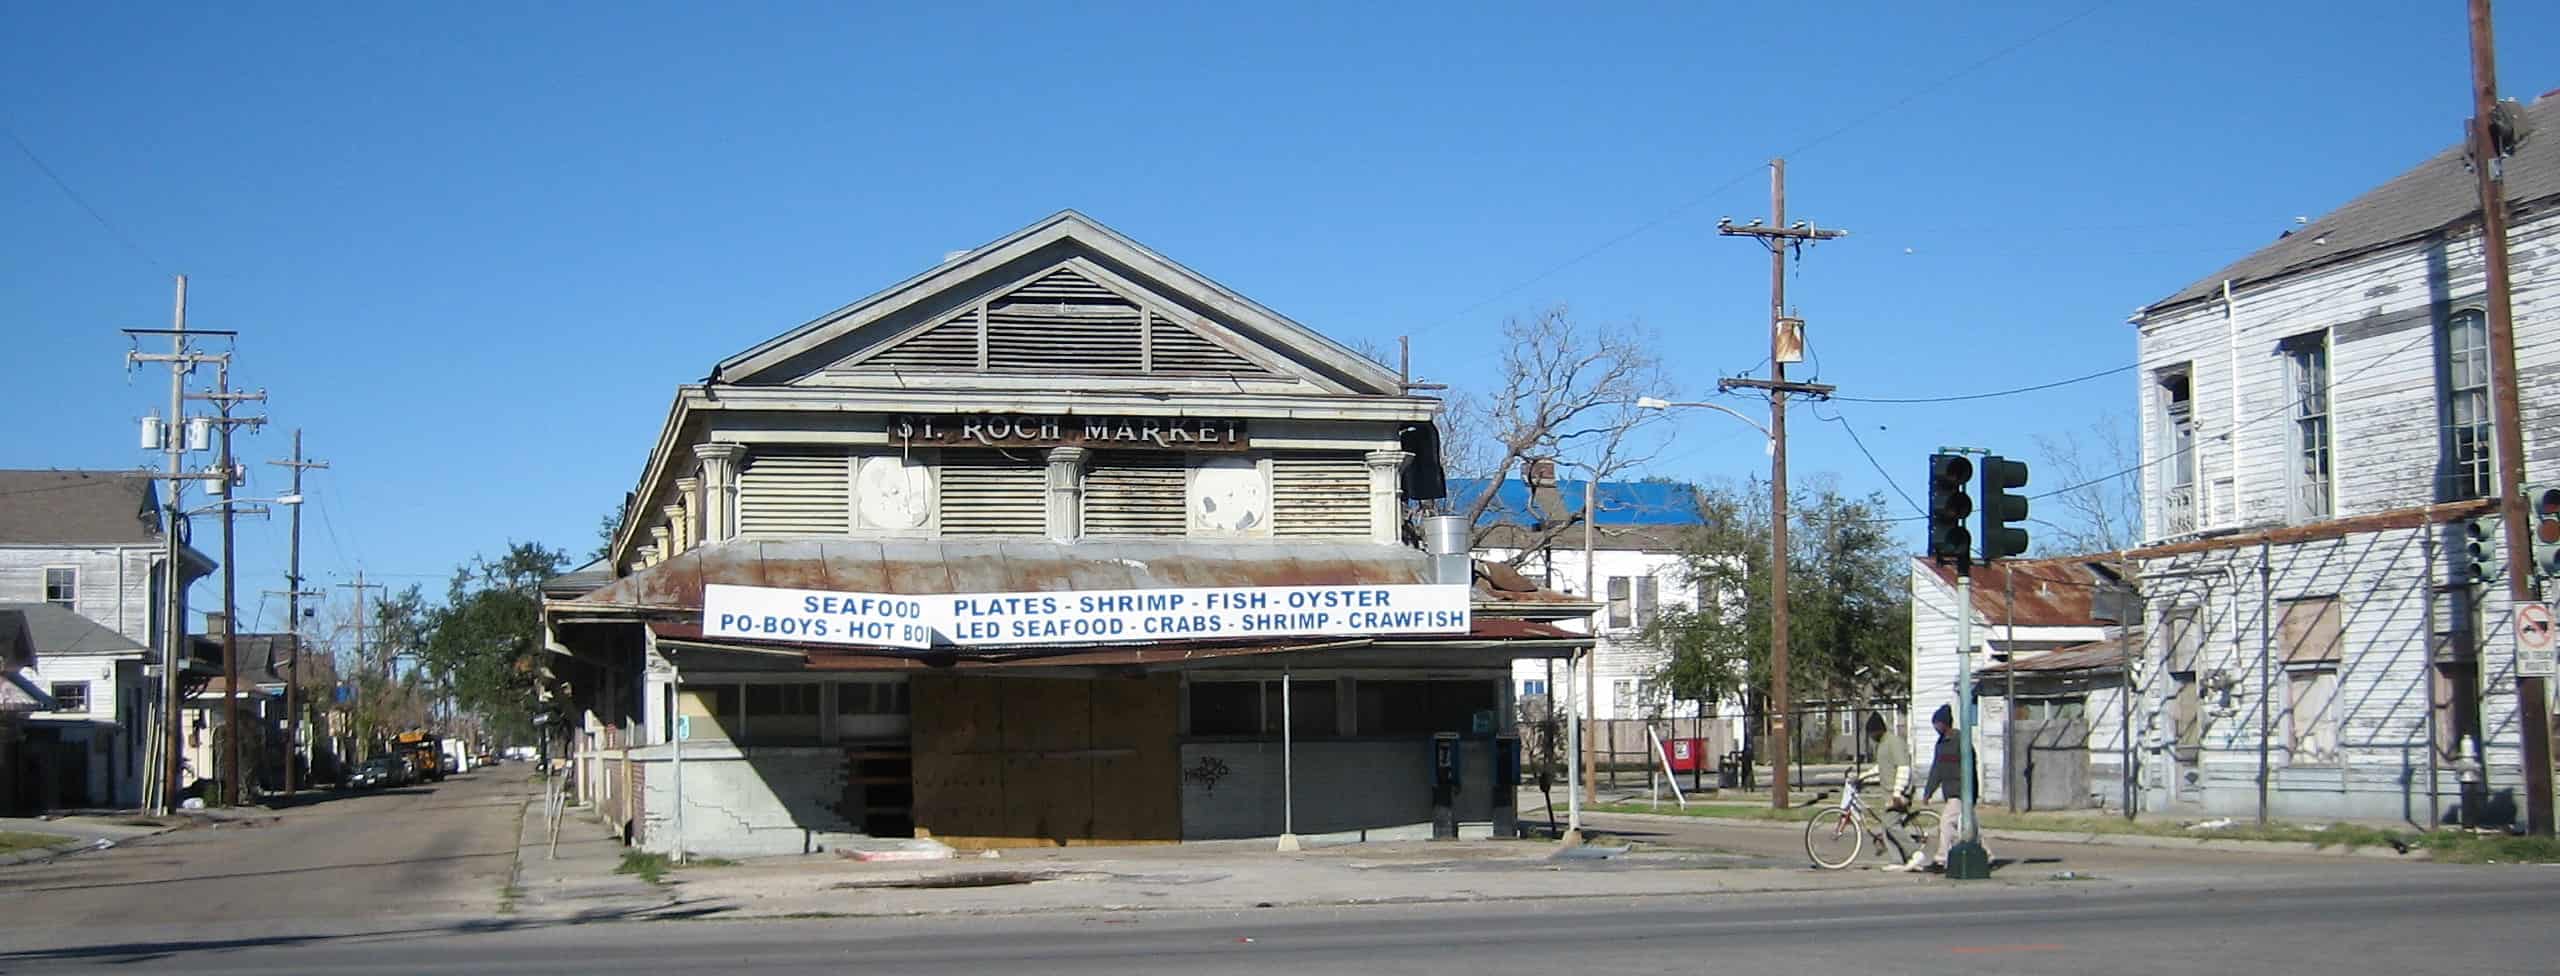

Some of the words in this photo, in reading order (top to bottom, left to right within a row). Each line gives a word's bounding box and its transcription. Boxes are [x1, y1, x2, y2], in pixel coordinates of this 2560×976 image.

[897, 415, 943, 439] ST.
[961, 415, 1061, 446] ROCH
[1084, 416, 1241, 448] MARKET
[803, 595, 921, 619] SEAFOOD
[954, 598, 1058, 616] PLATES
[1079, 593, 1185, 614] SHRIMP
[1206, 592, 1267, 610] FISH
[1287, 590, 1391, 609] OYSTER
[720, 613, 829, 637] PO-BOYS
[848, 620, 895, 640] HOT
[955, 621, 1001, 640] LED
[1012, 617, 1124, 638] SEAFOOD
[1143, 615, 1222, 634] CRABS
[1242, 612, 1330, 632] SHRIMP
[1348, 610, 1464, 629] CRAWFISH
